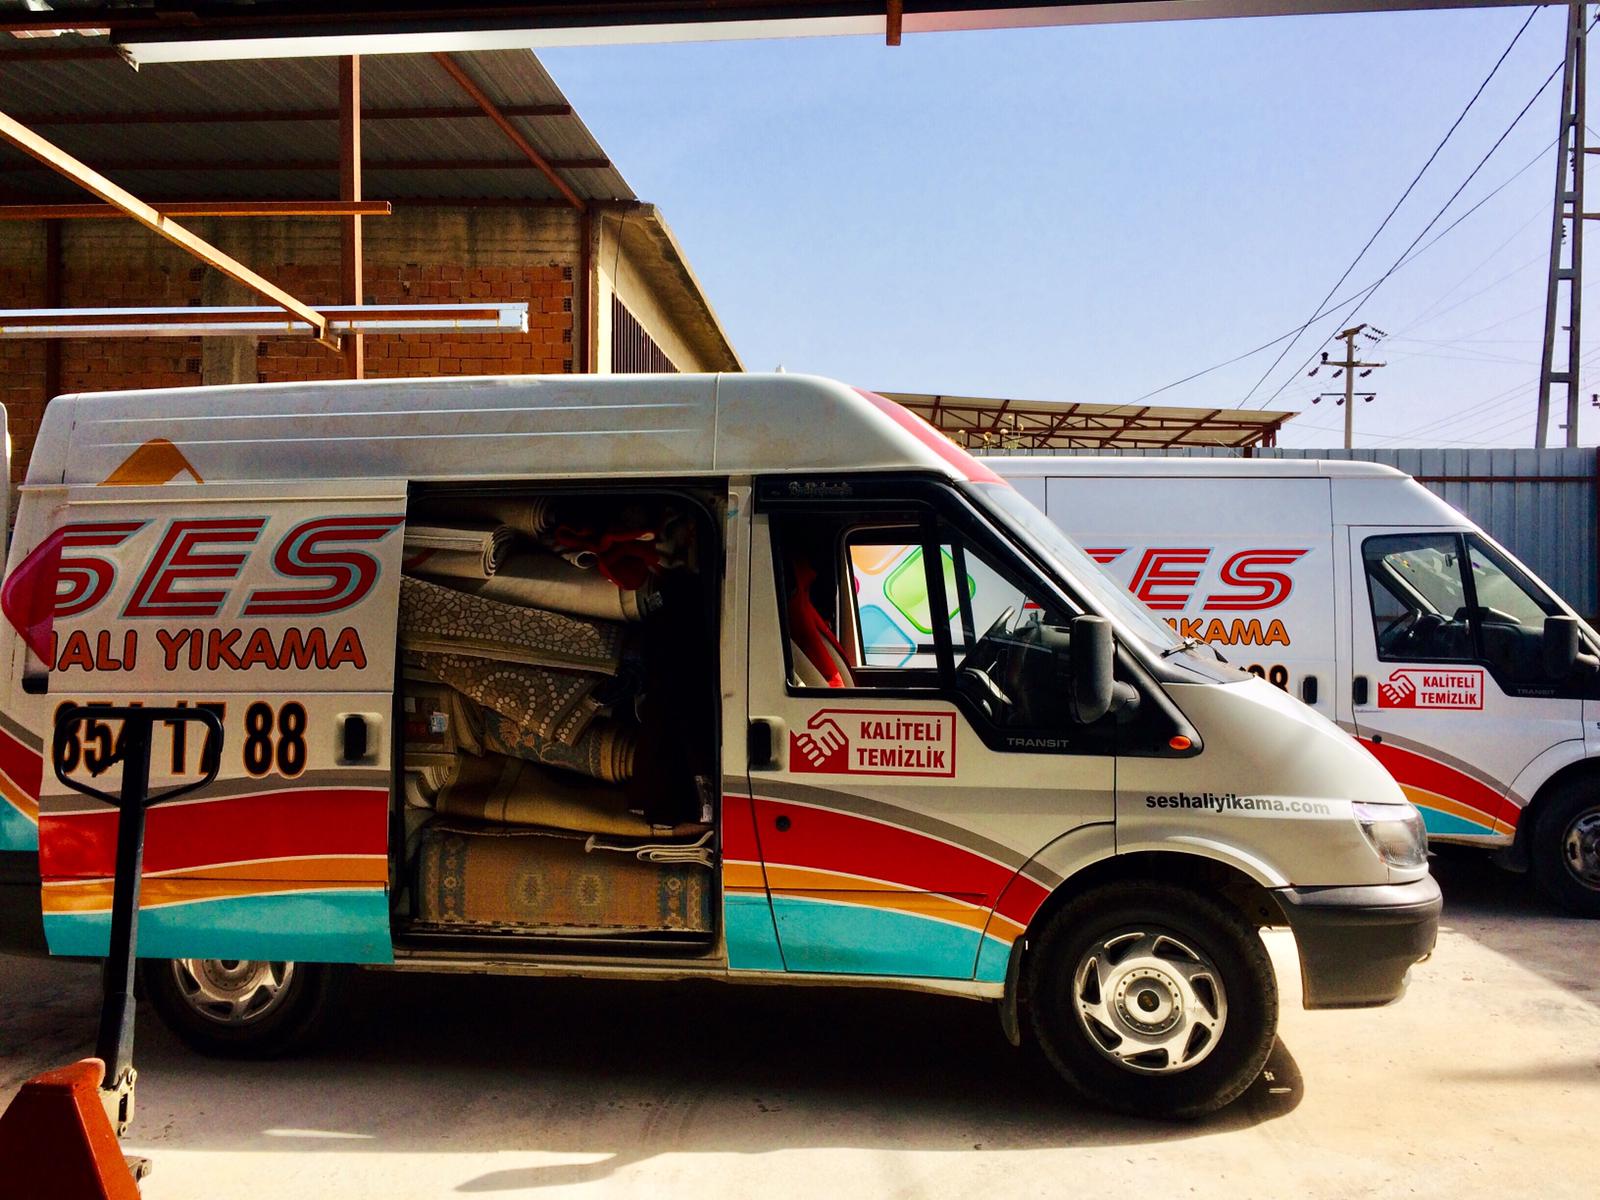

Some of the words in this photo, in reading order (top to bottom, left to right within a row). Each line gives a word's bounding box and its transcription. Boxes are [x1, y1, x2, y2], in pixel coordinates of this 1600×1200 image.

[1083, 547, 1315, 613] ES
[156, 627, 367, 671] YIKAMA
[1422, 675, 1475, 689] KALİTELİ
[1420, 690, 1477, 705] TEMİZLİK
[242, 701, 308, 778] 88
[860, 718, 942, 742] KALİTELİ
[1006, 737, 1070, 748] TRANSIT
[856, 745, 946, 769] TEMİZLİK
[1145, 792, 1330, 815] seshaliyikama.com
